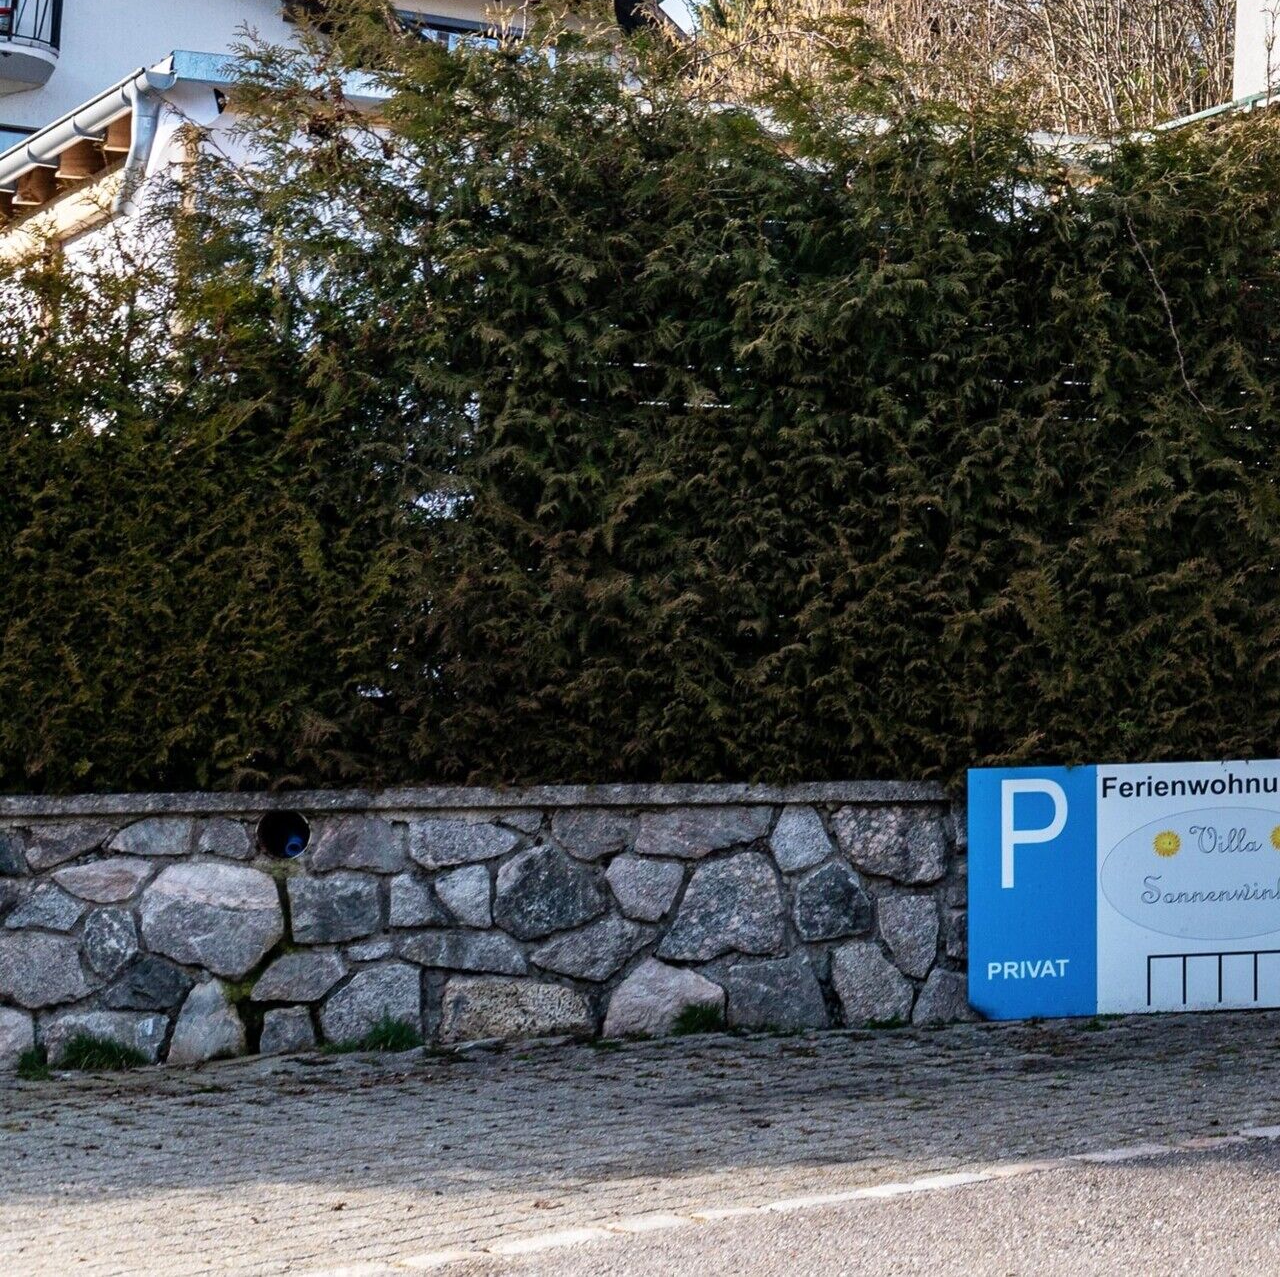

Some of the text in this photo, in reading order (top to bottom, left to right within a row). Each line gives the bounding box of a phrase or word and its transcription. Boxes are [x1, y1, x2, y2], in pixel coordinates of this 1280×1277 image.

[1001, 778, 1068, 889] P
[1189, 825, 1263, 855] Villa
[987, 959, 1070, 981] PRIVAT
